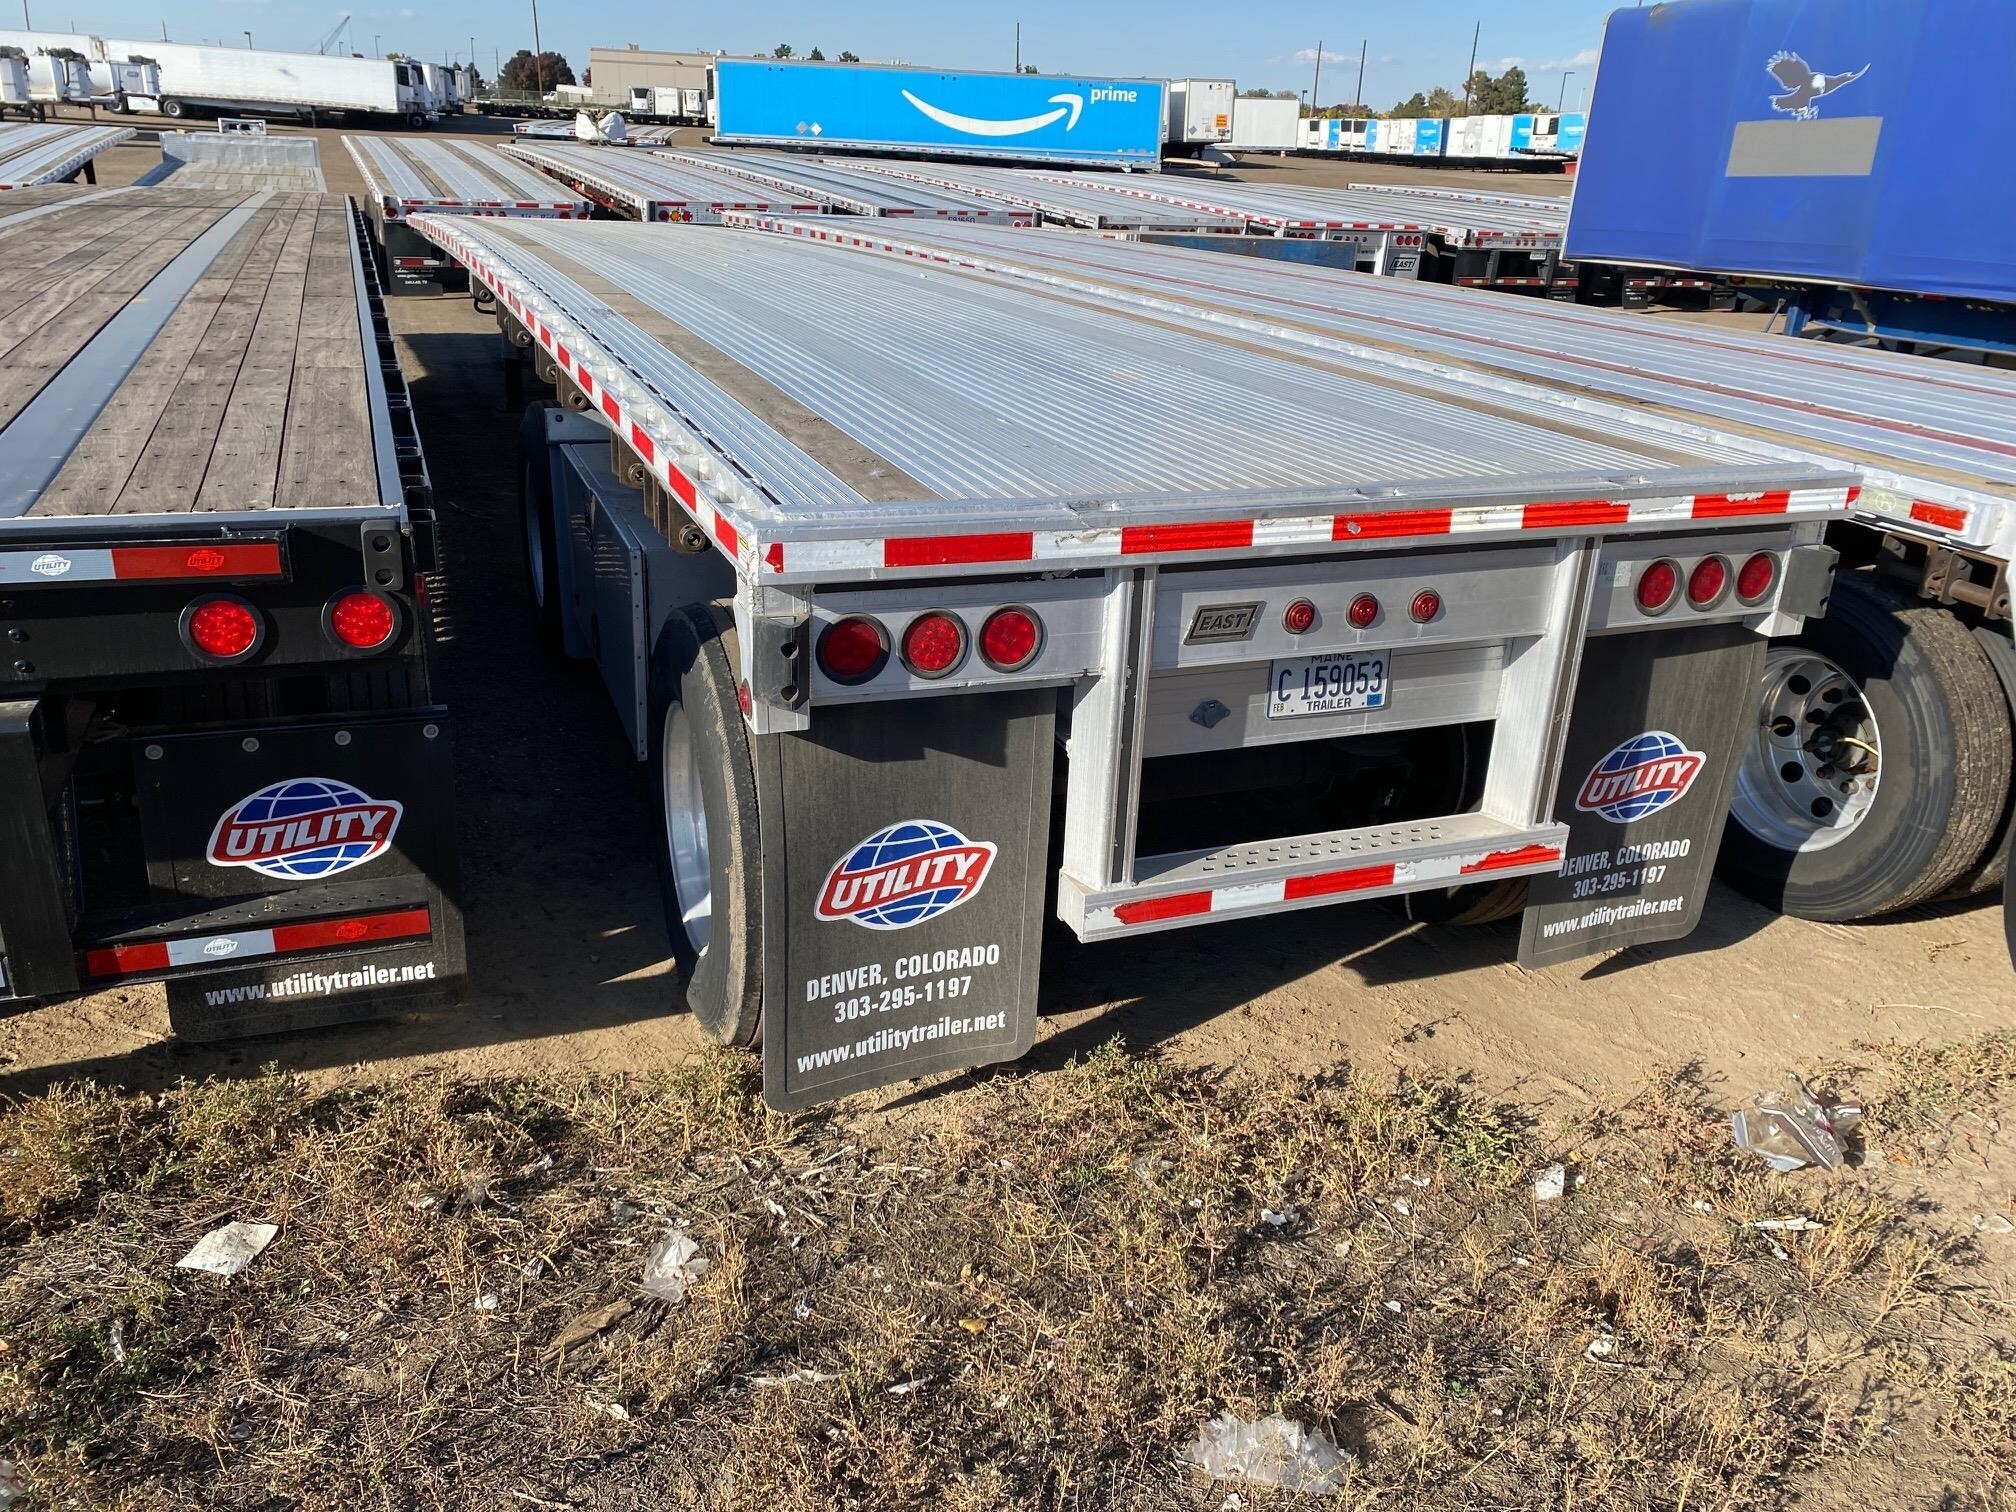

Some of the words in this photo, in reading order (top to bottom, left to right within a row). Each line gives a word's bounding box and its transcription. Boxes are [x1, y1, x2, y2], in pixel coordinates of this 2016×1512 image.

[1090, 86, 1137, 104] prime
[1394, 260, 1412, 268] EAST
[34, 561, 69, 571] UTILITY
[1199, 613, 1248, 631] EAST
[1277, 669, 1292, 702] C
[1300, 660, 1383, 700] 159053
[1273, 703, 1285, 712] FEB
[1306, 697, 1352, 711] TRAILER
[1590, 761, 1694, 803] UTILITY
[226, 811, 389, 857] UTILITY
[1558, 851, 1612, 878] DENVER,
[1616, 839, 1691, 865] COLORADO
[830, 852, 982, 910] UTILITY
[1573, 865, 1667, 899] 303-295-1197
[1543, 895, 1684, 938] www.utilitytrailer.net
[206, 961, 436, 1007] www.utilitytrailer.net
[806, 963, 888, 1002] DENVER,
[895, 944, 1000, 980] COLORADO
[834, 976, 972, 1023] 303-295-1197
[797, 1010, 1006, 1073] www.utilitytrailer.net
